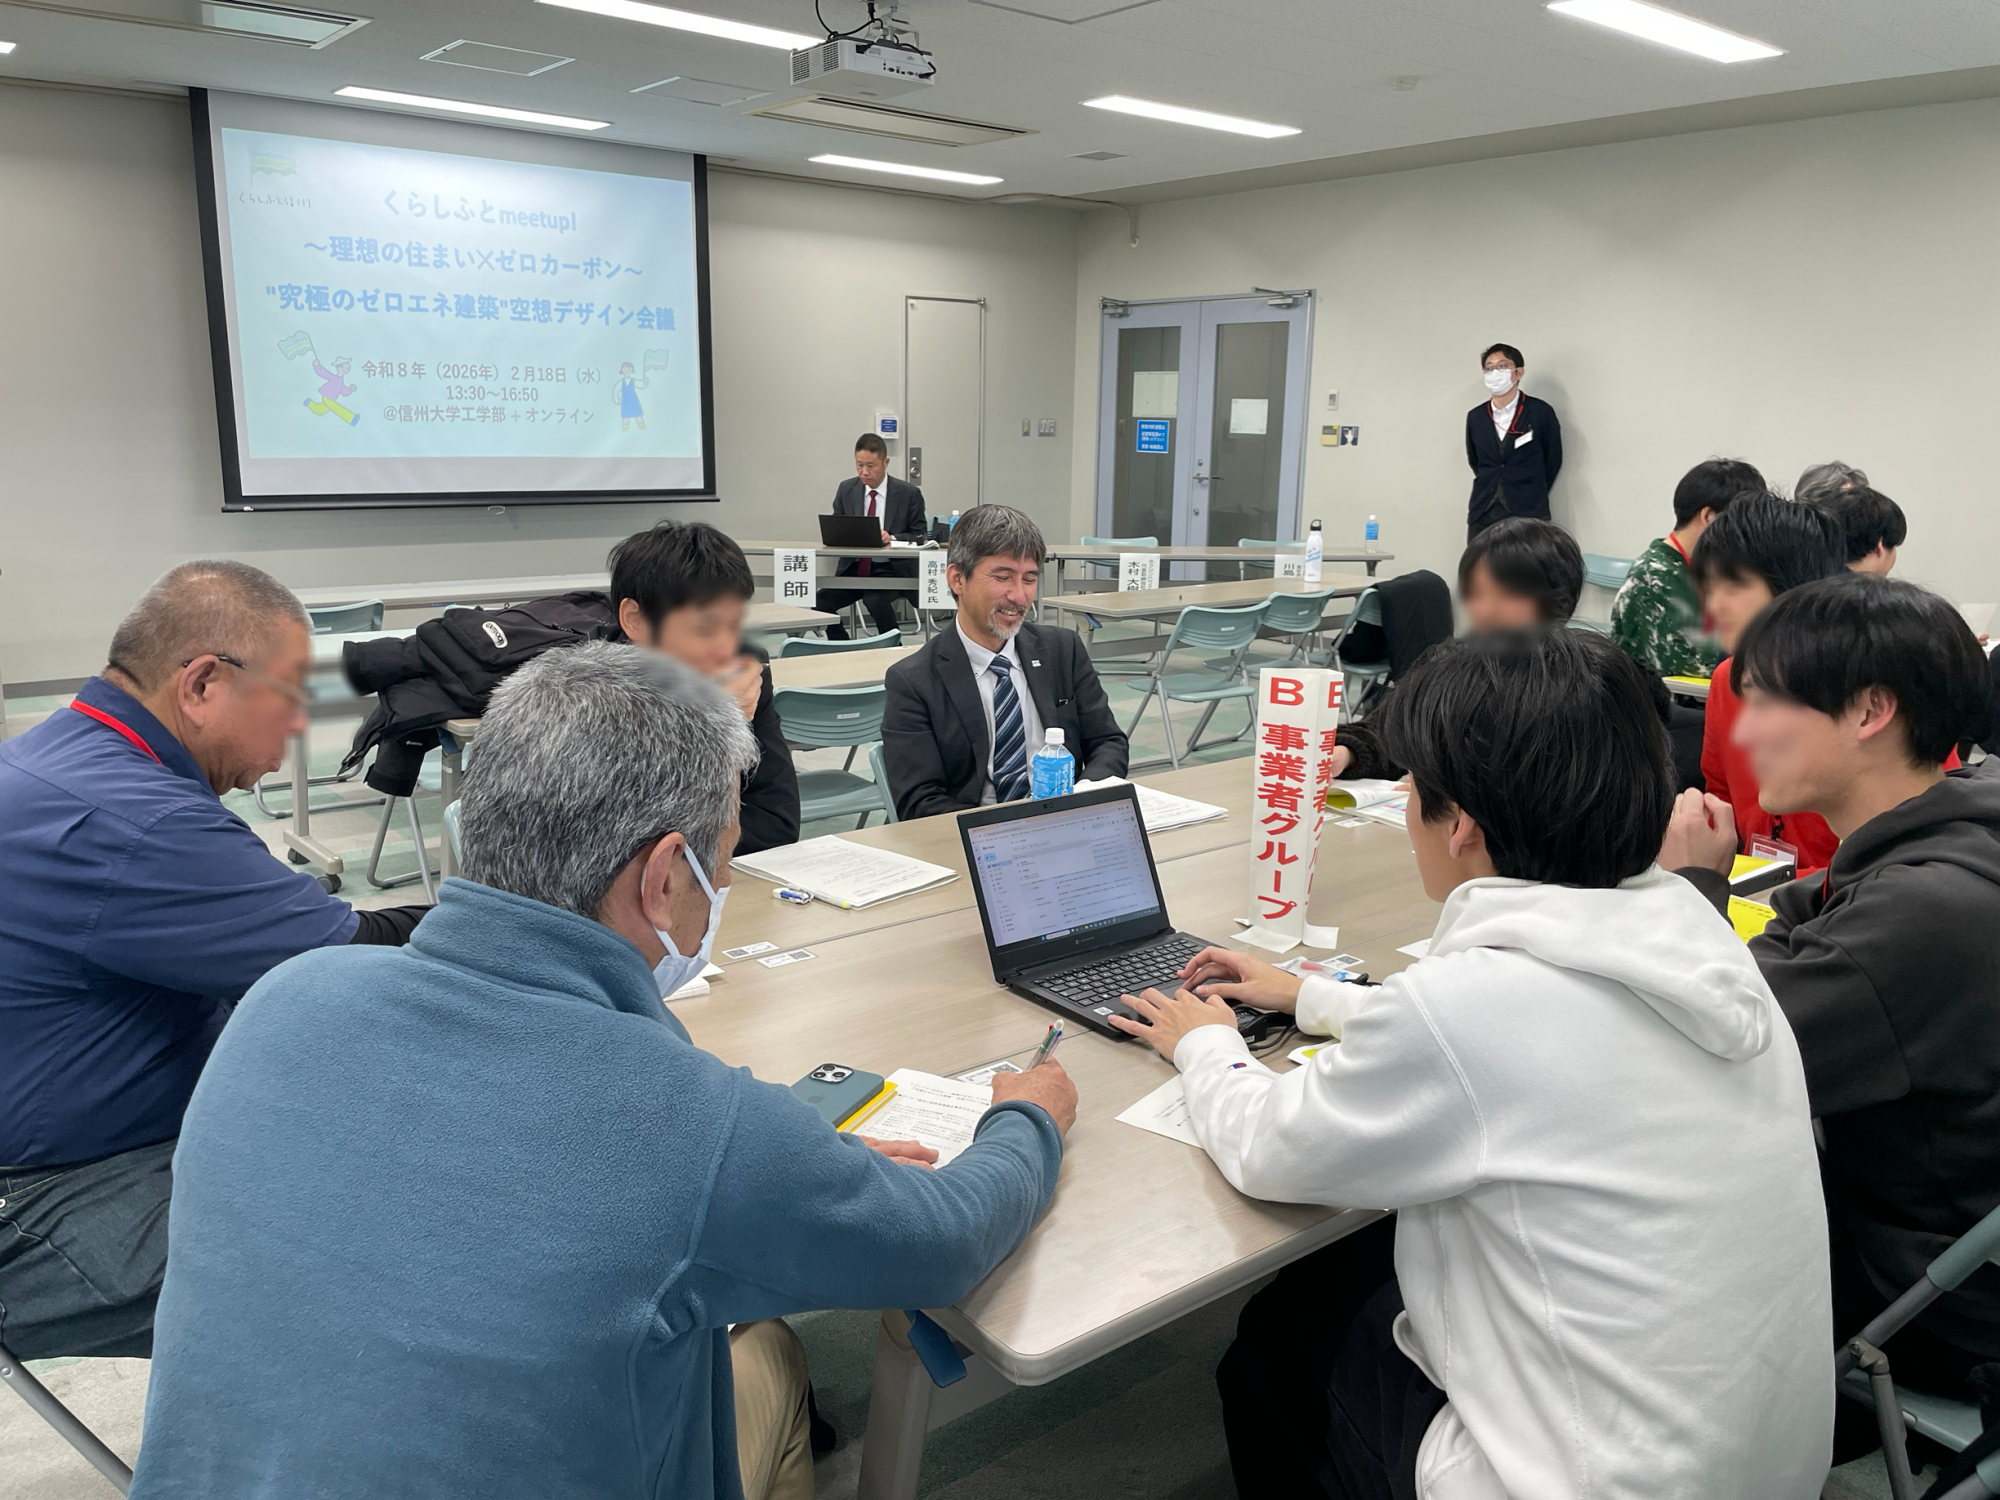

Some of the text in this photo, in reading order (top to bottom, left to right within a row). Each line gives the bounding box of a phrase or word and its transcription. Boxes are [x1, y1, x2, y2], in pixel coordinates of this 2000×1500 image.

[384, 190, 577, 235] くらしふとmeetup!
[783, 555, 809, 598] 講師
[1269, 677, 1304, 706] B
[1257, 722, 1309, 919] 事業者グループ
